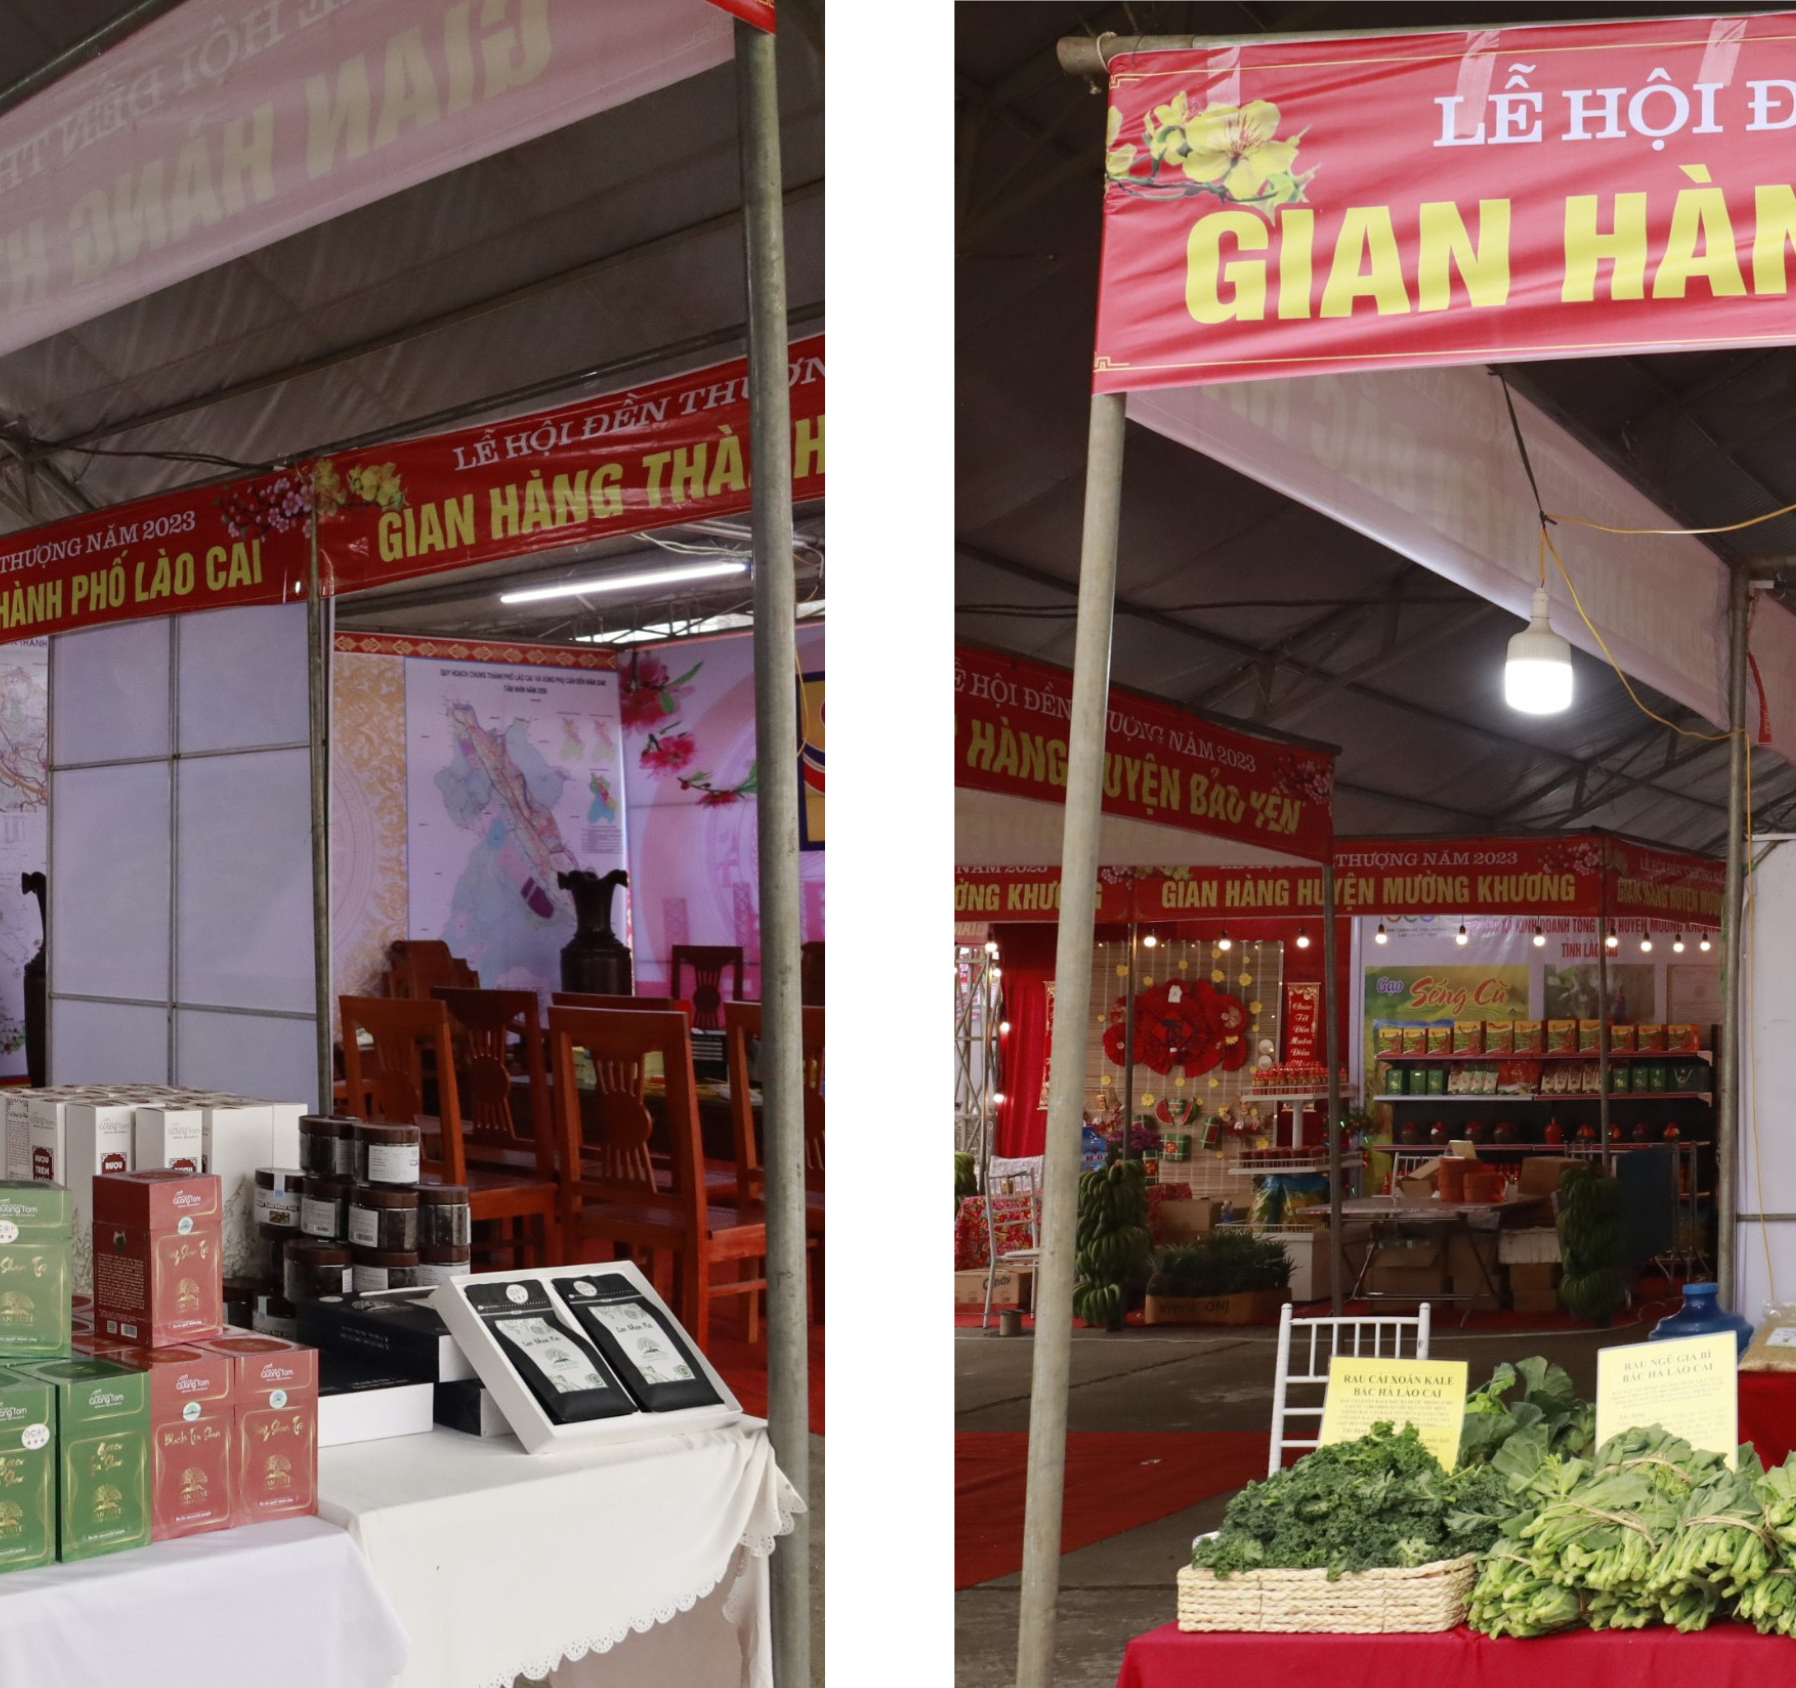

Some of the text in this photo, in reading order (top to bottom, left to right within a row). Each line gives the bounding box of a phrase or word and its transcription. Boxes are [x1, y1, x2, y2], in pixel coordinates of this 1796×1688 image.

[1432, 62, 1541, 148] LỄ
[1562, 67, 1727, 152] HỘI
[1183, 198, 1512, 325] GIAN
[453, 392, 670, 471] LỄ HỘI ĐỀN
[85, 522, 142, 553] NĂM
[143, 510, 197, 541] 2023
[377, 462, 624, 562] GIAN HÀNG
[70, 548, 127, 613] PHỐ
[134, 547, 196, 603] LÀO
[206, 540, 264, 592] CAI
[969, 672, 1256, 774] HỘI ĐỀN NĂM 2023
[966, 716, 1303, 834] HÀNG BẢO YÊN
[1161, 870, 1576, 909] GIAN HÀNG MƯỜNG KHƯƠNG
[1335, 850, 1519, 869] THƯỢNG NĂM 2023
[1376, 975, 1404, 997] Gạo
[1343, 1374, 1365, 1384] RAU
[1424, 1375, 1454, 1386] KALE
[1378, 1387, 1394, 1397] HÀ
[1421, 1388, 1442, 1398] CAI
